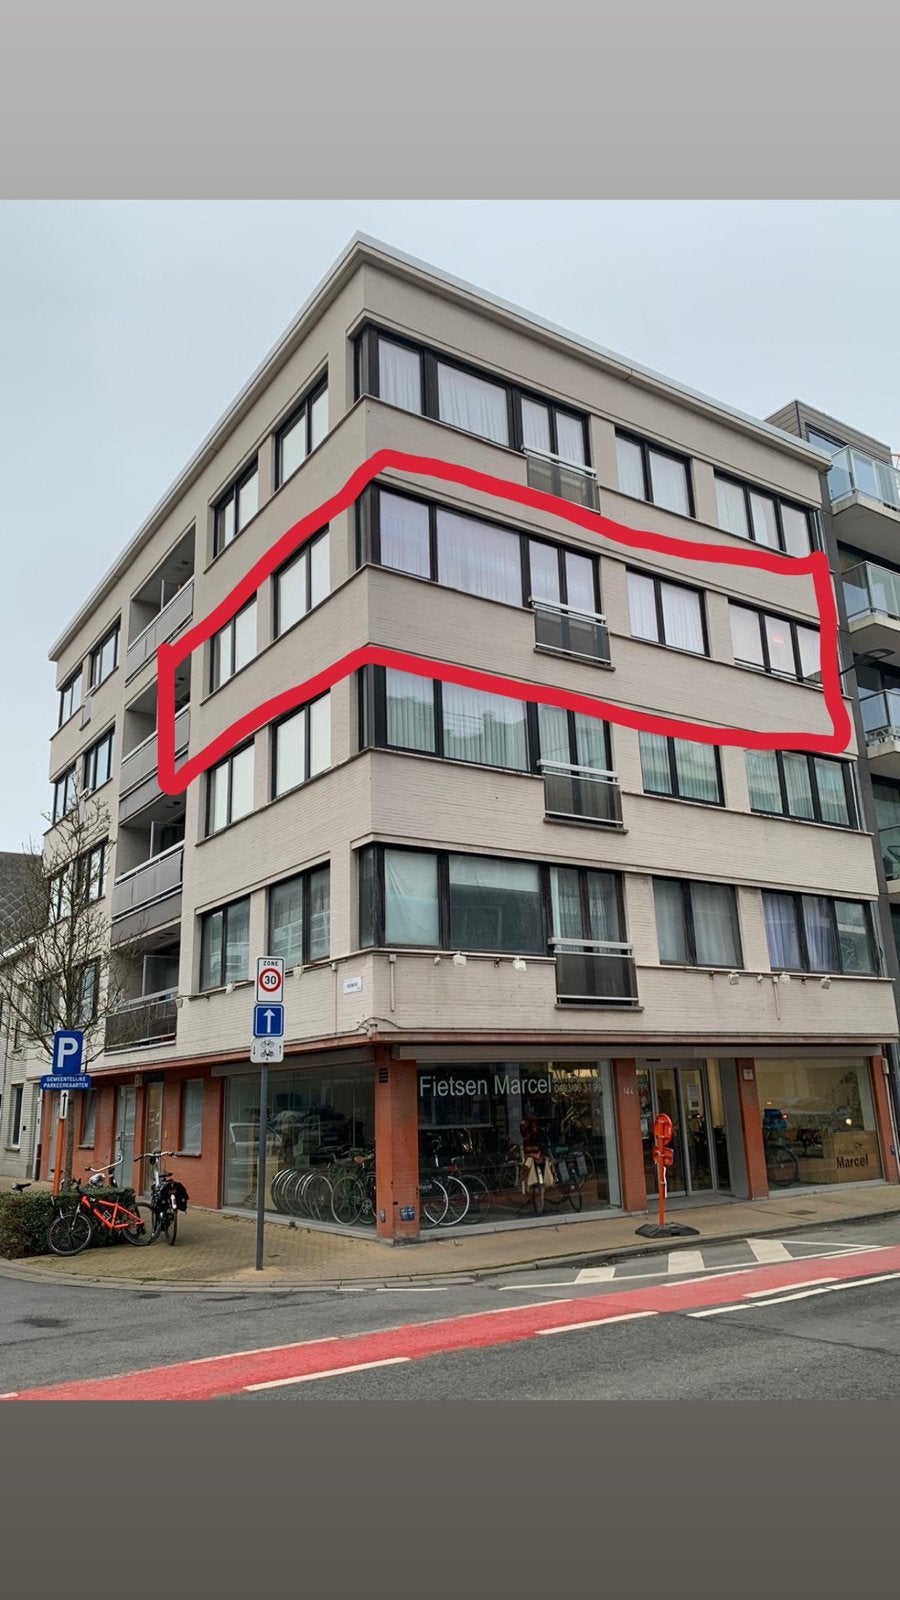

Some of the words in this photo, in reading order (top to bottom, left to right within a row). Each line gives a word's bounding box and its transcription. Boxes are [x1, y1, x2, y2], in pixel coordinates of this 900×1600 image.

[264, 975, 277, 985] 30
[57, 1037, 79, 1068] P
[420, 1076, 488, 1097] Fietsen
[494, 1073, 552, 1095] Marcel
[836, 1153, 869, 1169] Marcel
